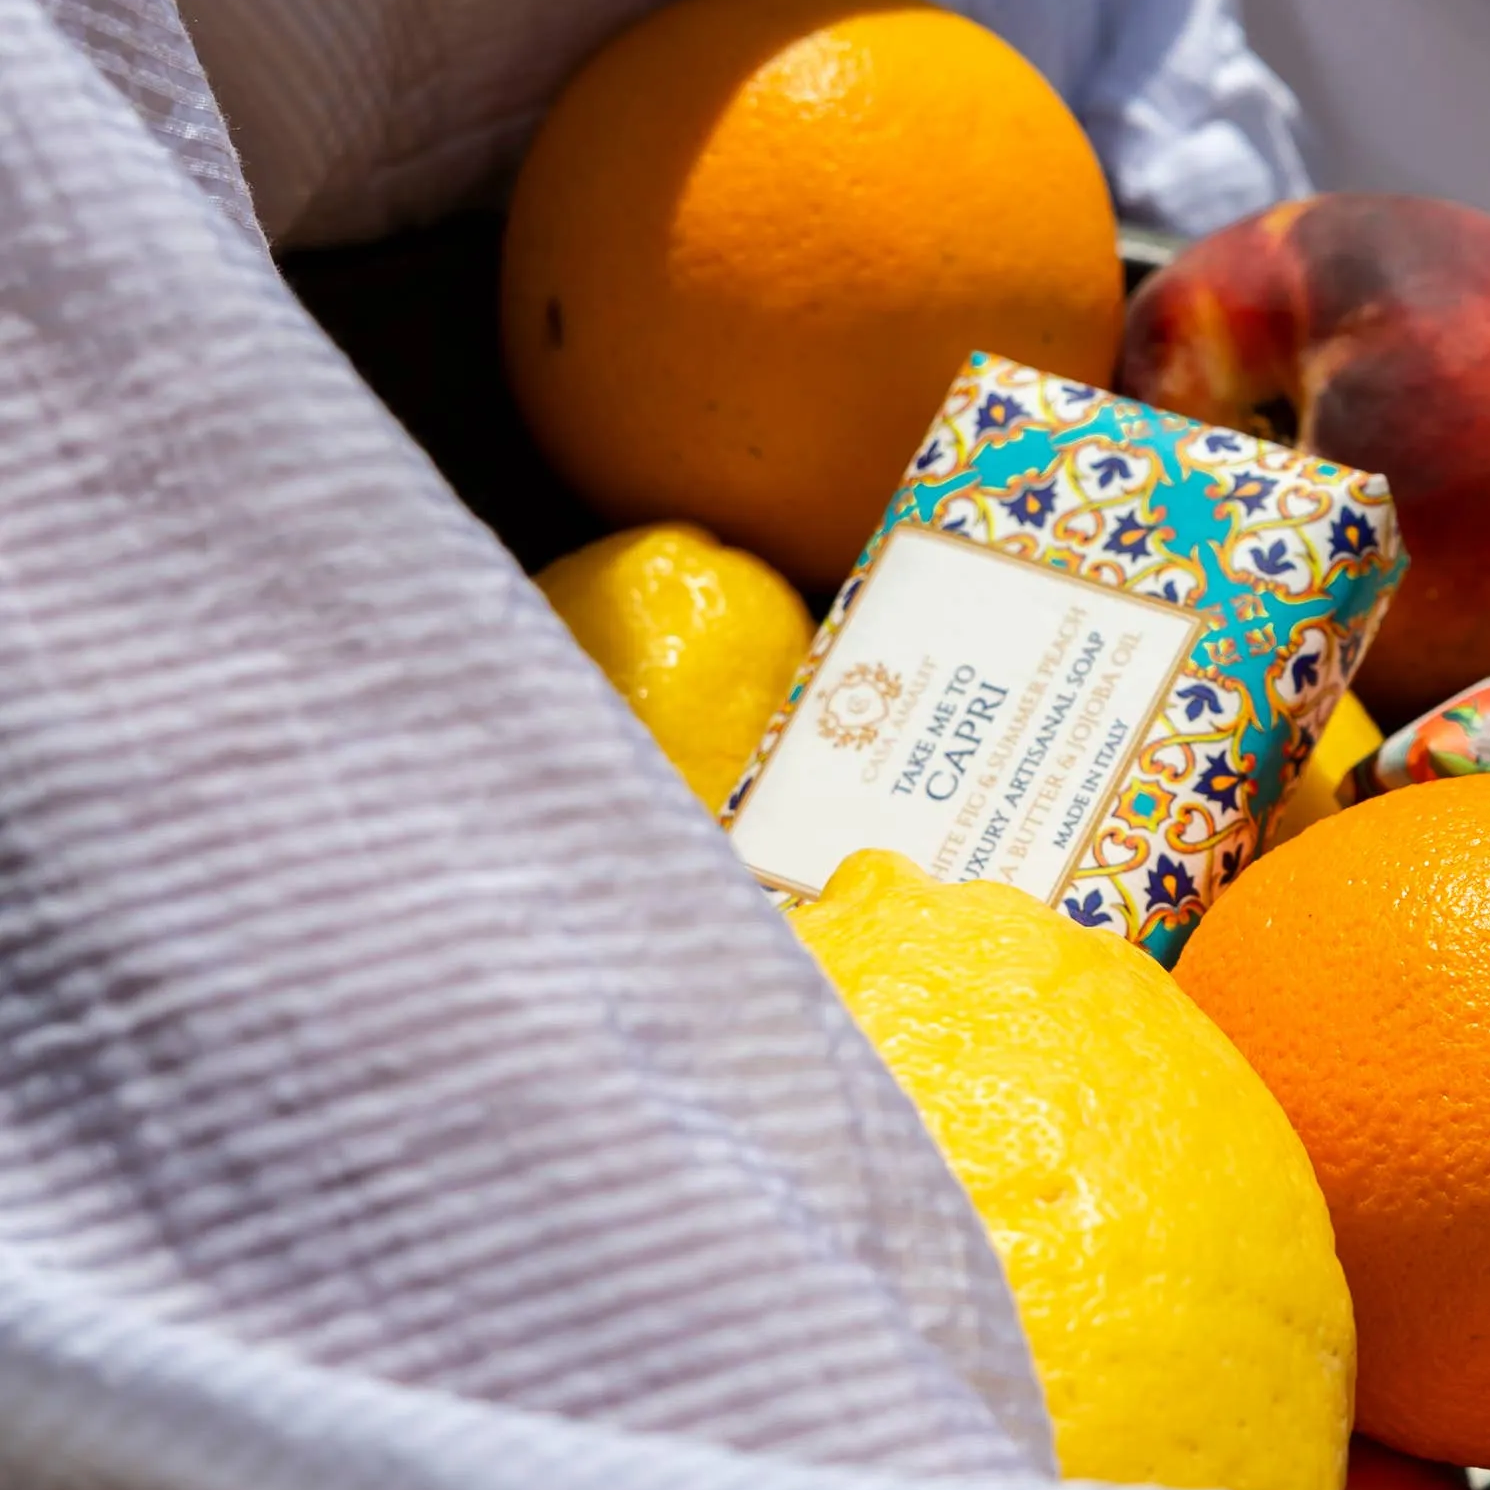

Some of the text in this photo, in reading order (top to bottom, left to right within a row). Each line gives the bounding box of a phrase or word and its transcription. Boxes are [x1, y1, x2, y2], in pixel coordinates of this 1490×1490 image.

[891, 664, 976, 797] TAKE ME TO
[925, 681, 1009, 802] CAPRI
[931, 833, 966, 880] HITE
[955, 792, 986, 829] FIG
[993, 680, 1049, 772] SUMMER
[1039, 606, 1088, 680] PEACH
[959, 809, 1010, 883] UXURY
[1004, 692, 1077, 808] ARTISANAL
[1066, 630, 1105, 688] SOAP
[1010, 776, 1064, 860] BUTTER
[1065, 671, 1122, 756] JOJOBA
[1111, 631, 1142, 668] OIL
[1053, 718, 1130, 850] MADE IN ITALY
